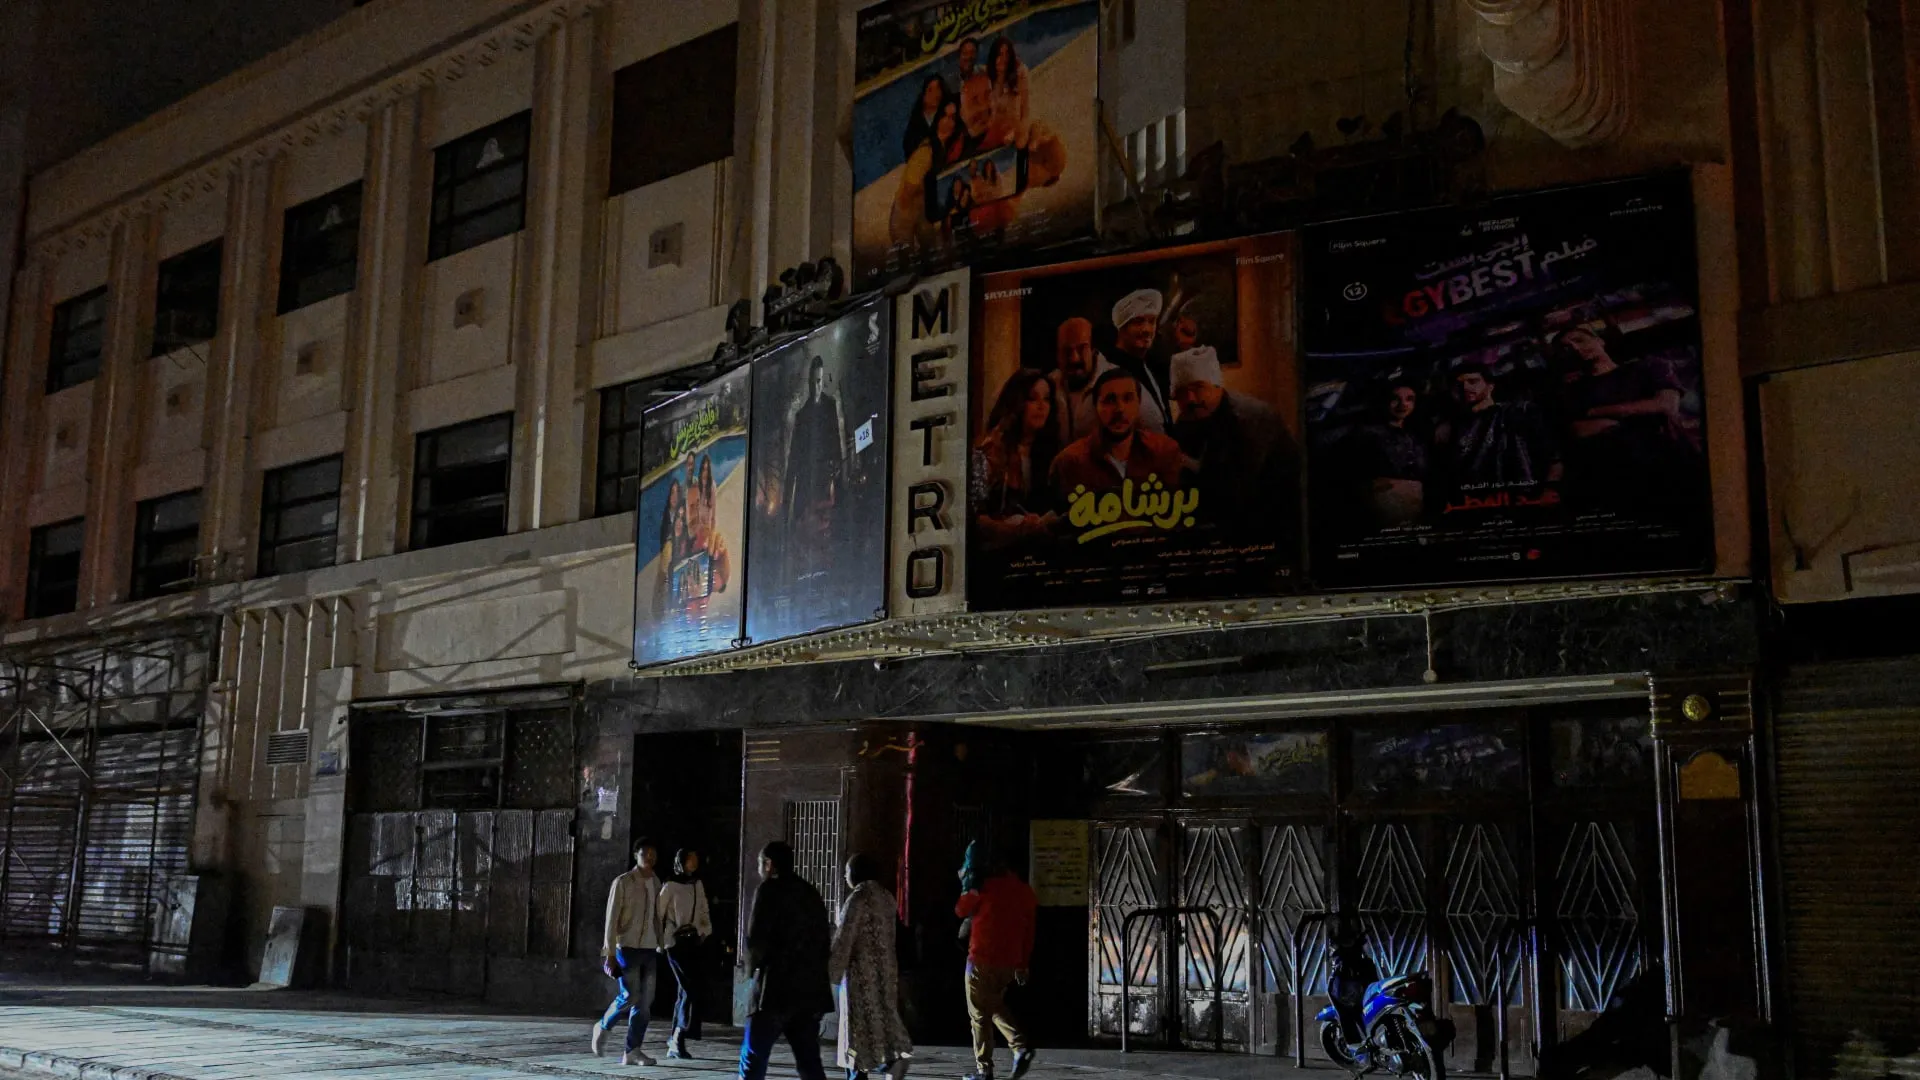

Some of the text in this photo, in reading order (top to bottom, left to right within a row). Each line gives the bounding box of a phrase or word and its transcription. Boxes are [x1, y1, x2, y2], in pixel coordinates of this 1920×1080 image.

[1540, 231, 1599, 276] فيلم
[907, 284, 958, 598] METRO
[1067, 472, 1199, 545] برشامة
